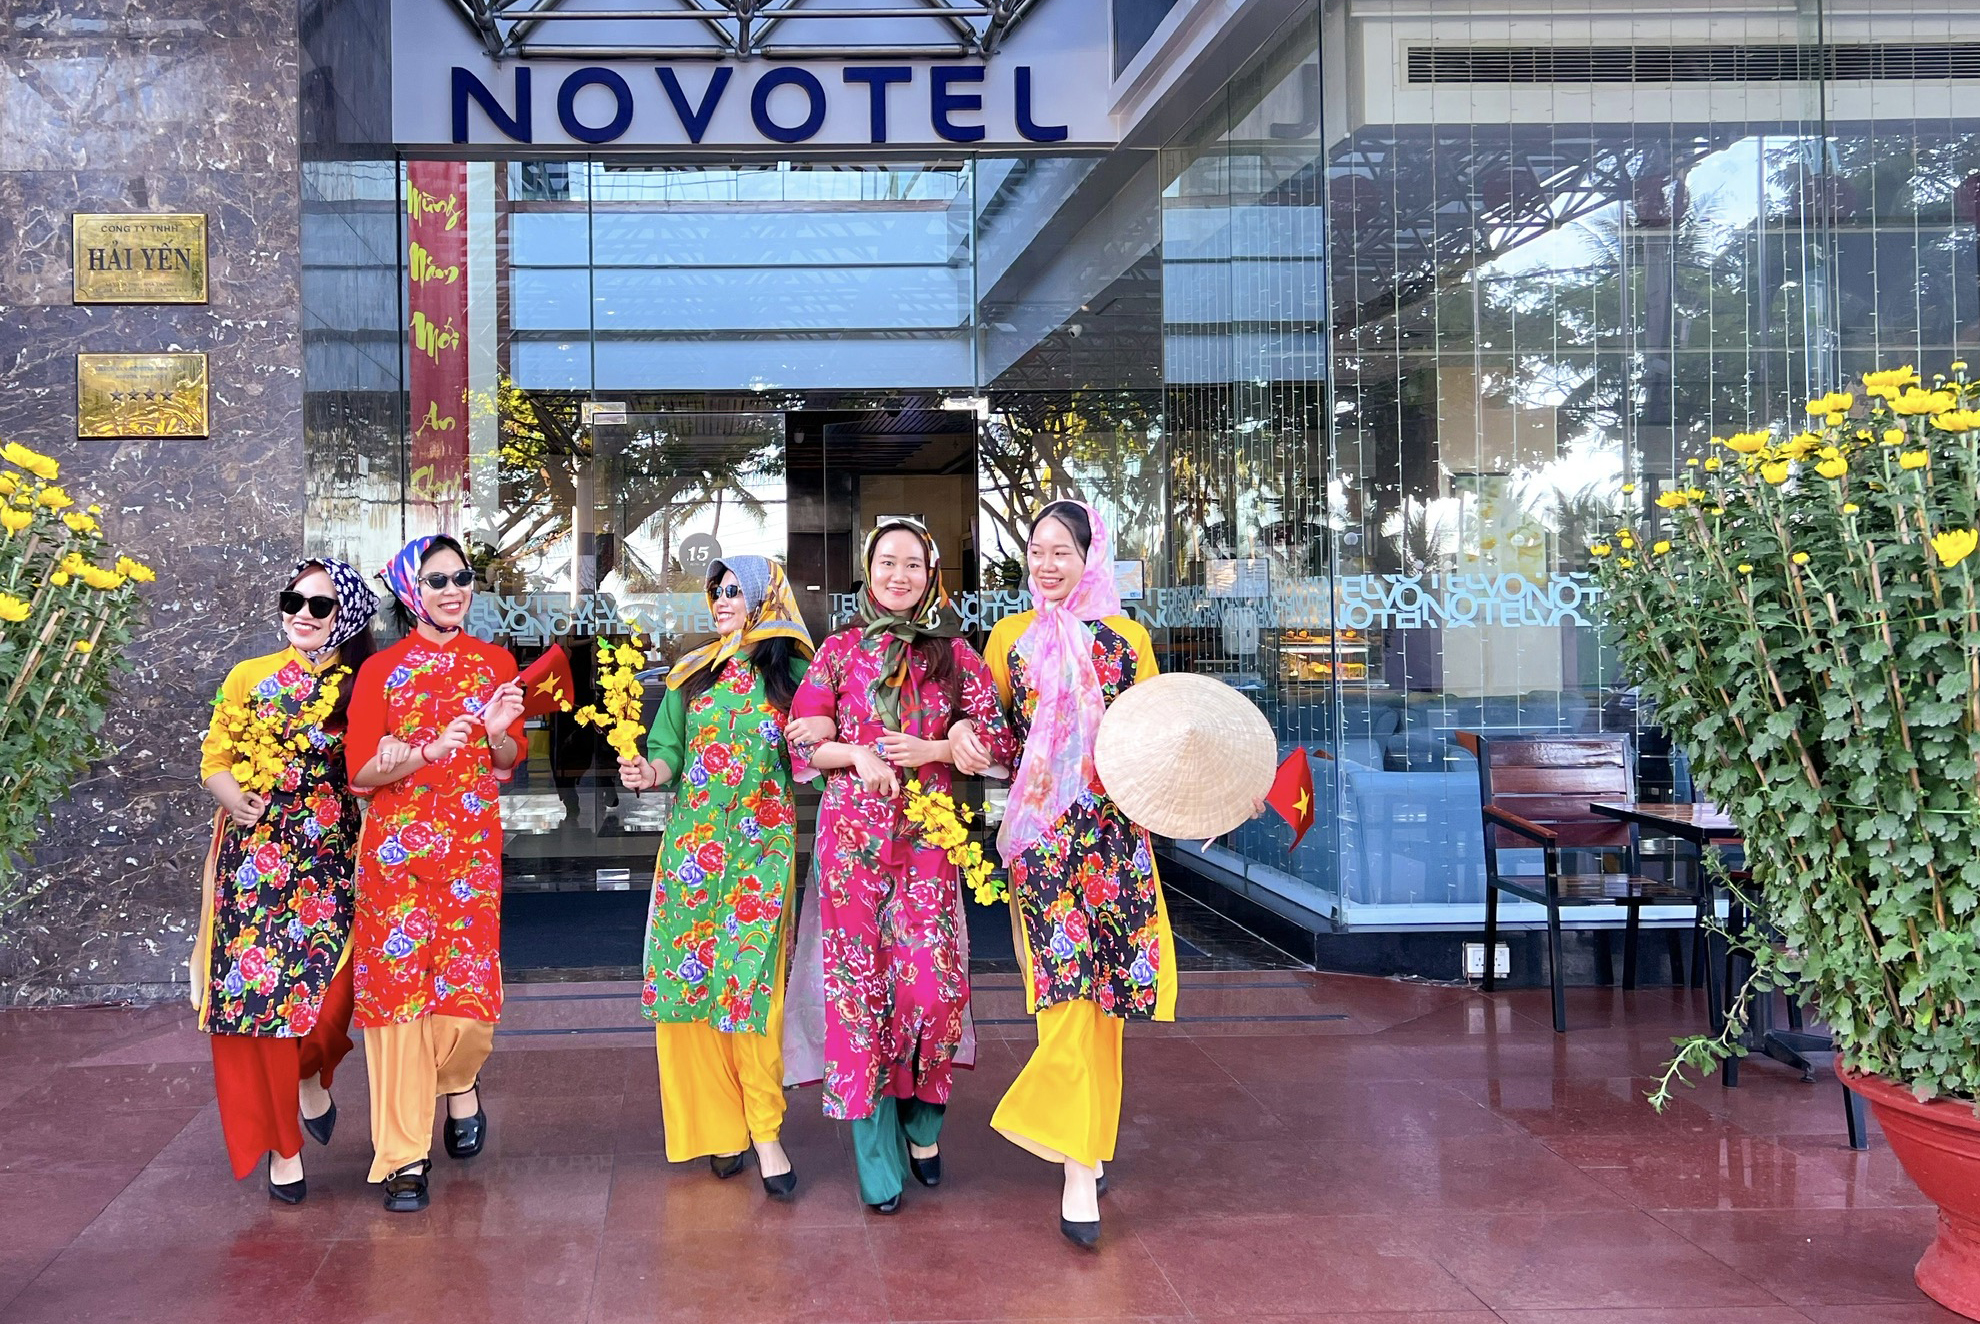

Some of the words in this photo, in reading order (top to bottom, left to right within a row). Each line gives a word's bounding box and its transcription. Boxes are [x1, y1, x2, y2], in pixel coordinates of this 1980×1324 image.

[451, 66, 1068, 144] NOVOTEL
[151, 225, 179, 233] TNHH
[87, 240, 133, 271] HẢI
[140, 239, 191, 271] YẾN
